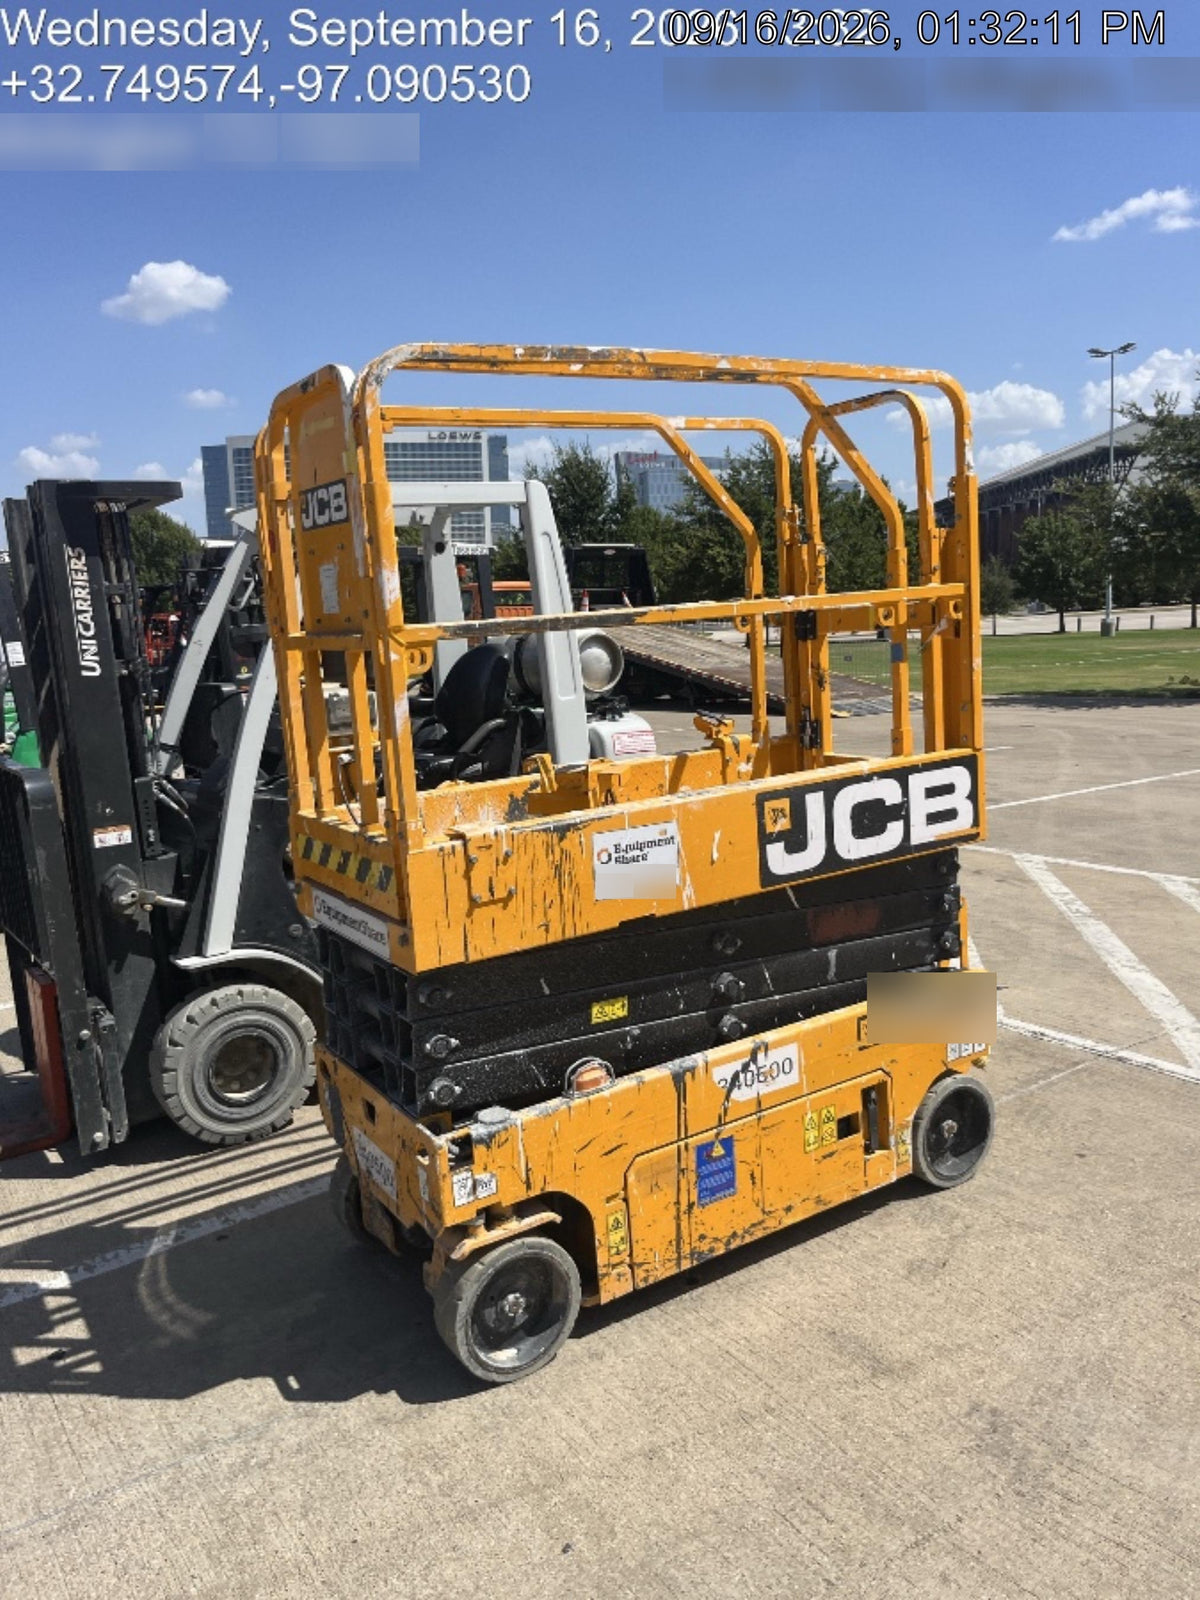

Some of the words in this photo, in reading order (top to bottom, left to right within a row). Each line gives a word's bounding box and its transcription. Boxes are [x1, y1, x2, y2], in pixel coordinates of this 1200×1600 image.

[427, 431, 482, 440] LOEWS
[301, 482, 348, 529] JCB
[66, 545, 102, 677] UNICARRIERS
[613, 835, 675, 854] Equipment
[765, 766, 974, 876] JCB
